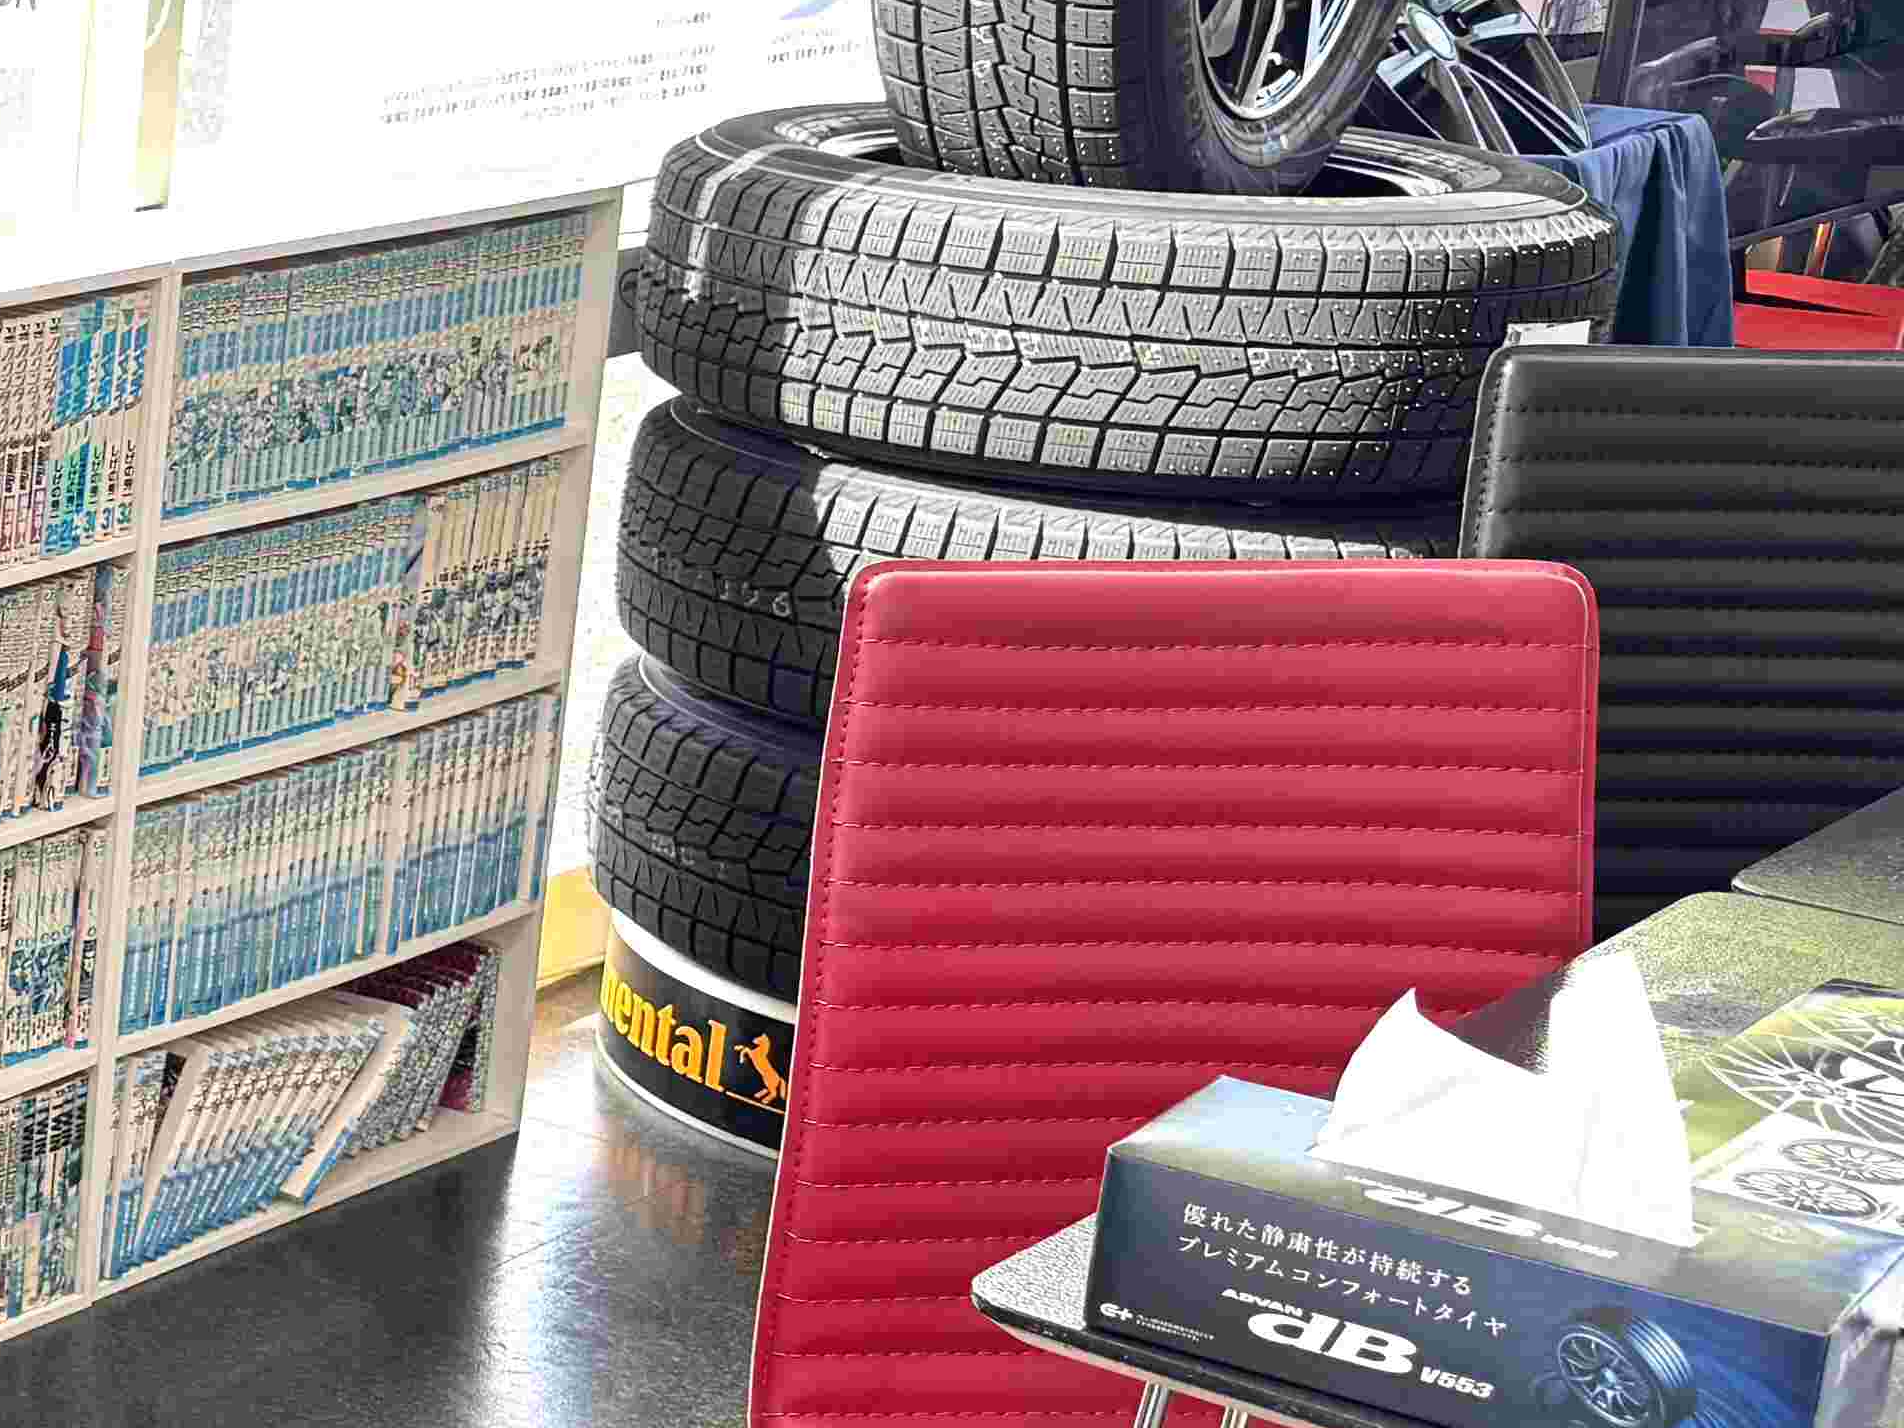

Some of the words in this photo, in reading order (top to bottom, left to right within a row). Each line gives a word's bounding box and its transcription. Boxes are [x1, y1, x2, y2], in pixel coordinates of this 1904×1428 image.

[1177, 1234, 1509, 1338] プレミアムコンフォートタイヤ
[1182, 1202, 1473, 1296] 優れた静粛性が持続する
[1219, 1288, 1303, 1317] ADVAN
[1246, 1310, 1418, 1375] dB
